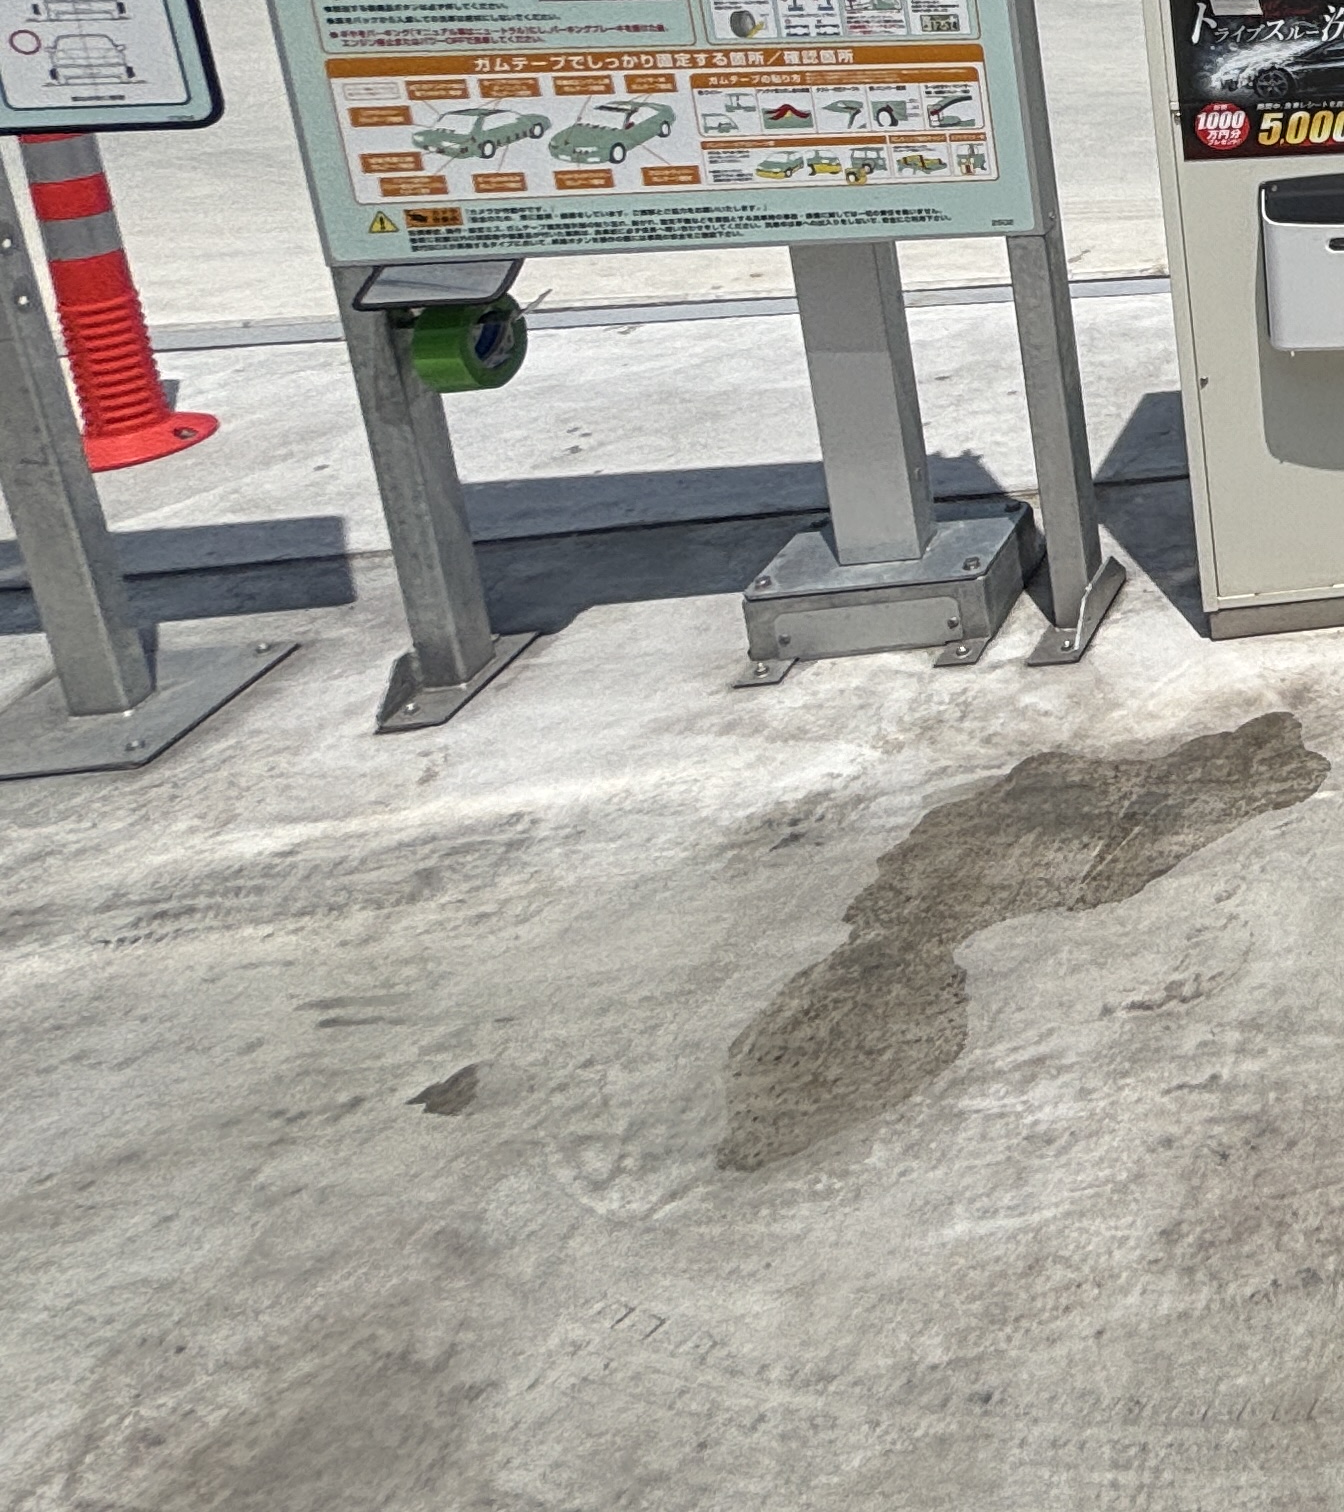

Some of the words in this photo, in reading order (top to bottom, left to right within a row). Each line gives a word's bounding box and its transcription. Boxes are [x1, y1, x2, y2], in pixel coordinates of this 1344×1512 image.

[1197, 110, 1245, 130] 1000
[1207, 130, 1241, 139] 万円分
